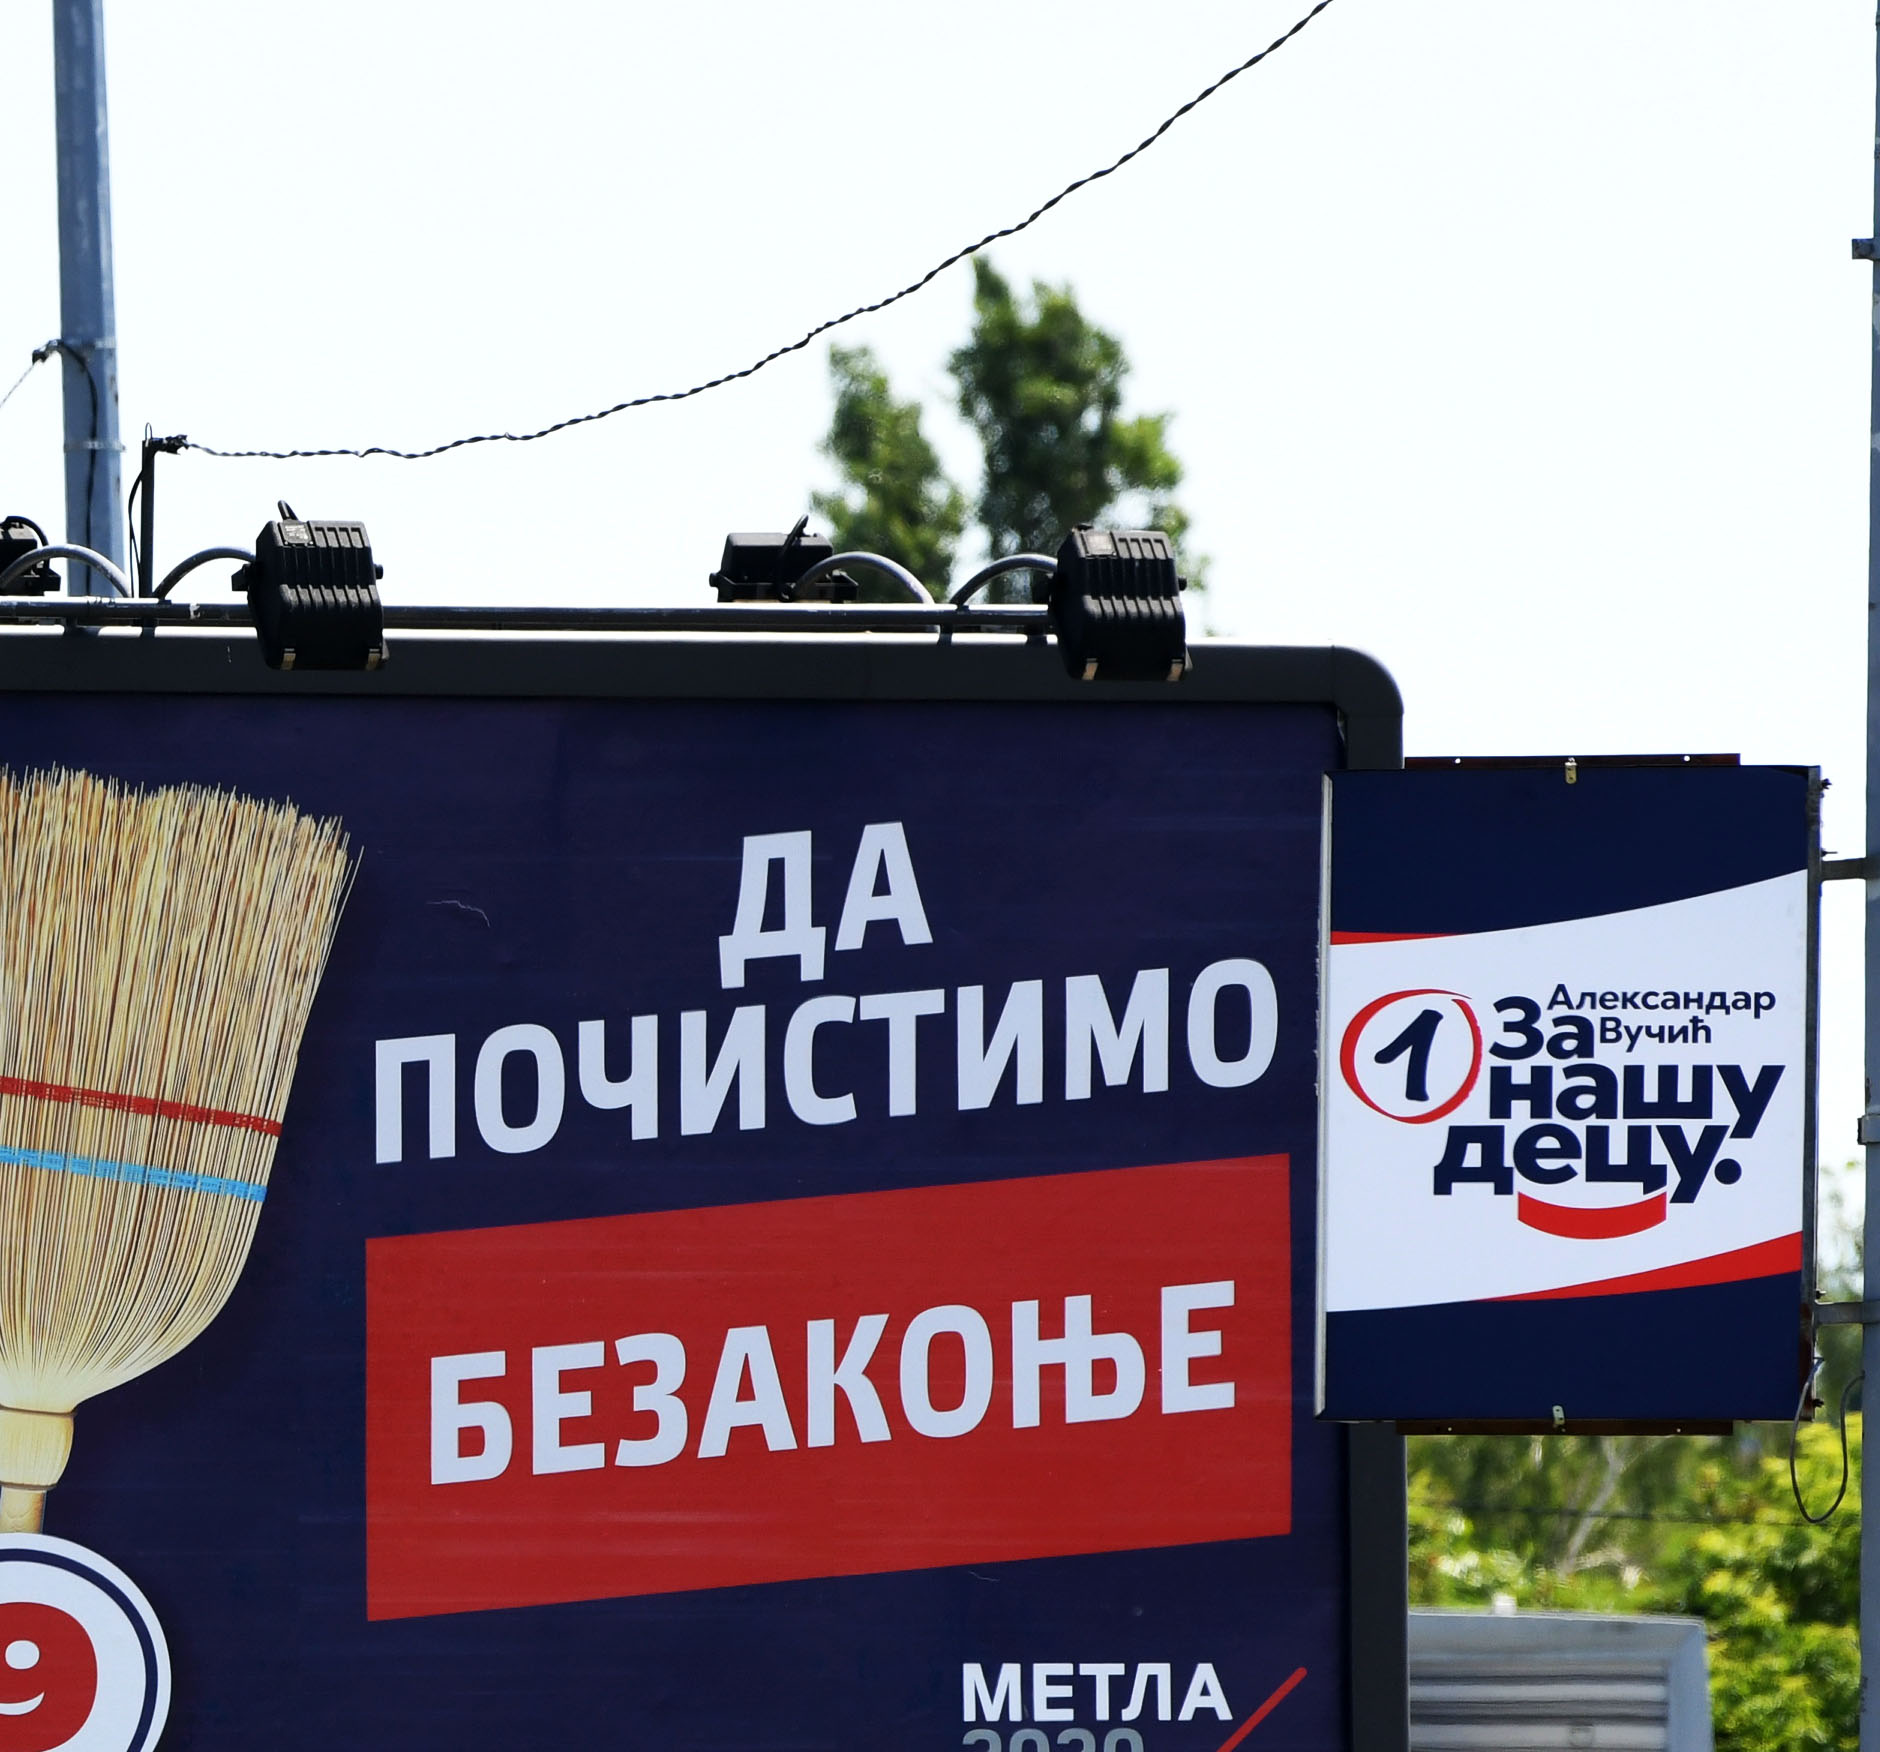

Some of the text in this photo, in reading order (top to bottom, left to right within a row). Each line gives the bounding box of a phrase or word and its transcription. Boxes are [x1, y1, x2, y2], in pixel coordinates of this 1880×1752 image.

[719, 822, 932, 988] ДА
[1489, 996, 1595, 1060] За
[1547, 984, 1775, 1019] Александар
[1600, 1016, 1711, 1052] Вучић
[376, 959, 1278, 1163] ПОЧИСТИМО
[1375, 1010, 1443, 1101] 1
[1489, 1064, 1785, 1138] нашу
[1433, 1124, 1741, 1203] децу.
[430, 1281, 1235, 1485] БЕЗАКОЊЕ
[962, 1662, 1233, 1722] МЕТЛА
